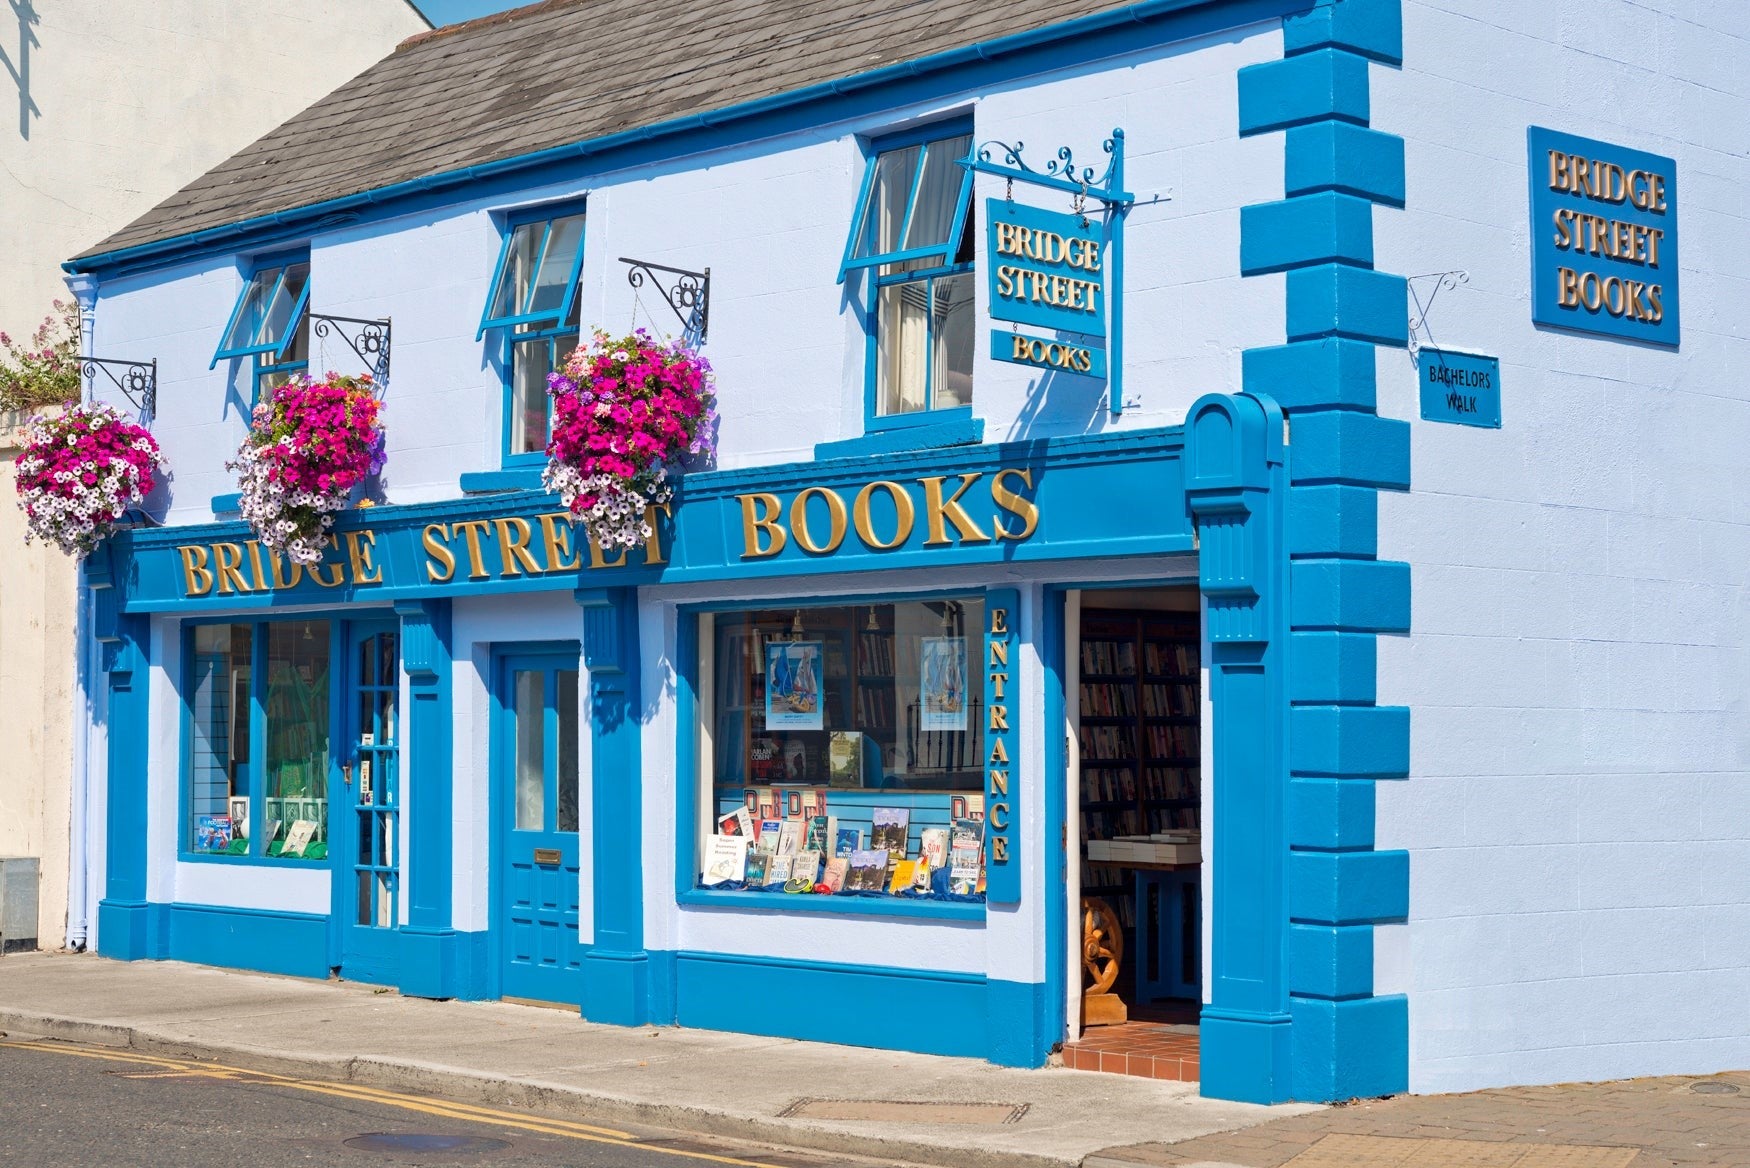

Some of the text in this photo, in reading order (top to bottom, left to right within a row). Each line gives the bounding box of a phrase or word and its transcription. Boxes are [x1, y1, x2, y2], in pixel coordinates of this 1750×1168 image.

[1548, 150, 1667, 212] BRIDGE
[995, 221, 1100, 272] BRIDGE
[1554, 208, 1664, 266] STREET
[997, 265, 1100, 312] STREET
[1557, 267, 1662, 322] BOOKS
[1012, 335, 1091, 372] BOOKS
[1429, 365, 1491, 389] BACHELORS
[1446, 393, 1477, 413] WALK
[735, 468, 1039, 557] BOOKS
[989, 608, 1010, 862] ENTRANCE
